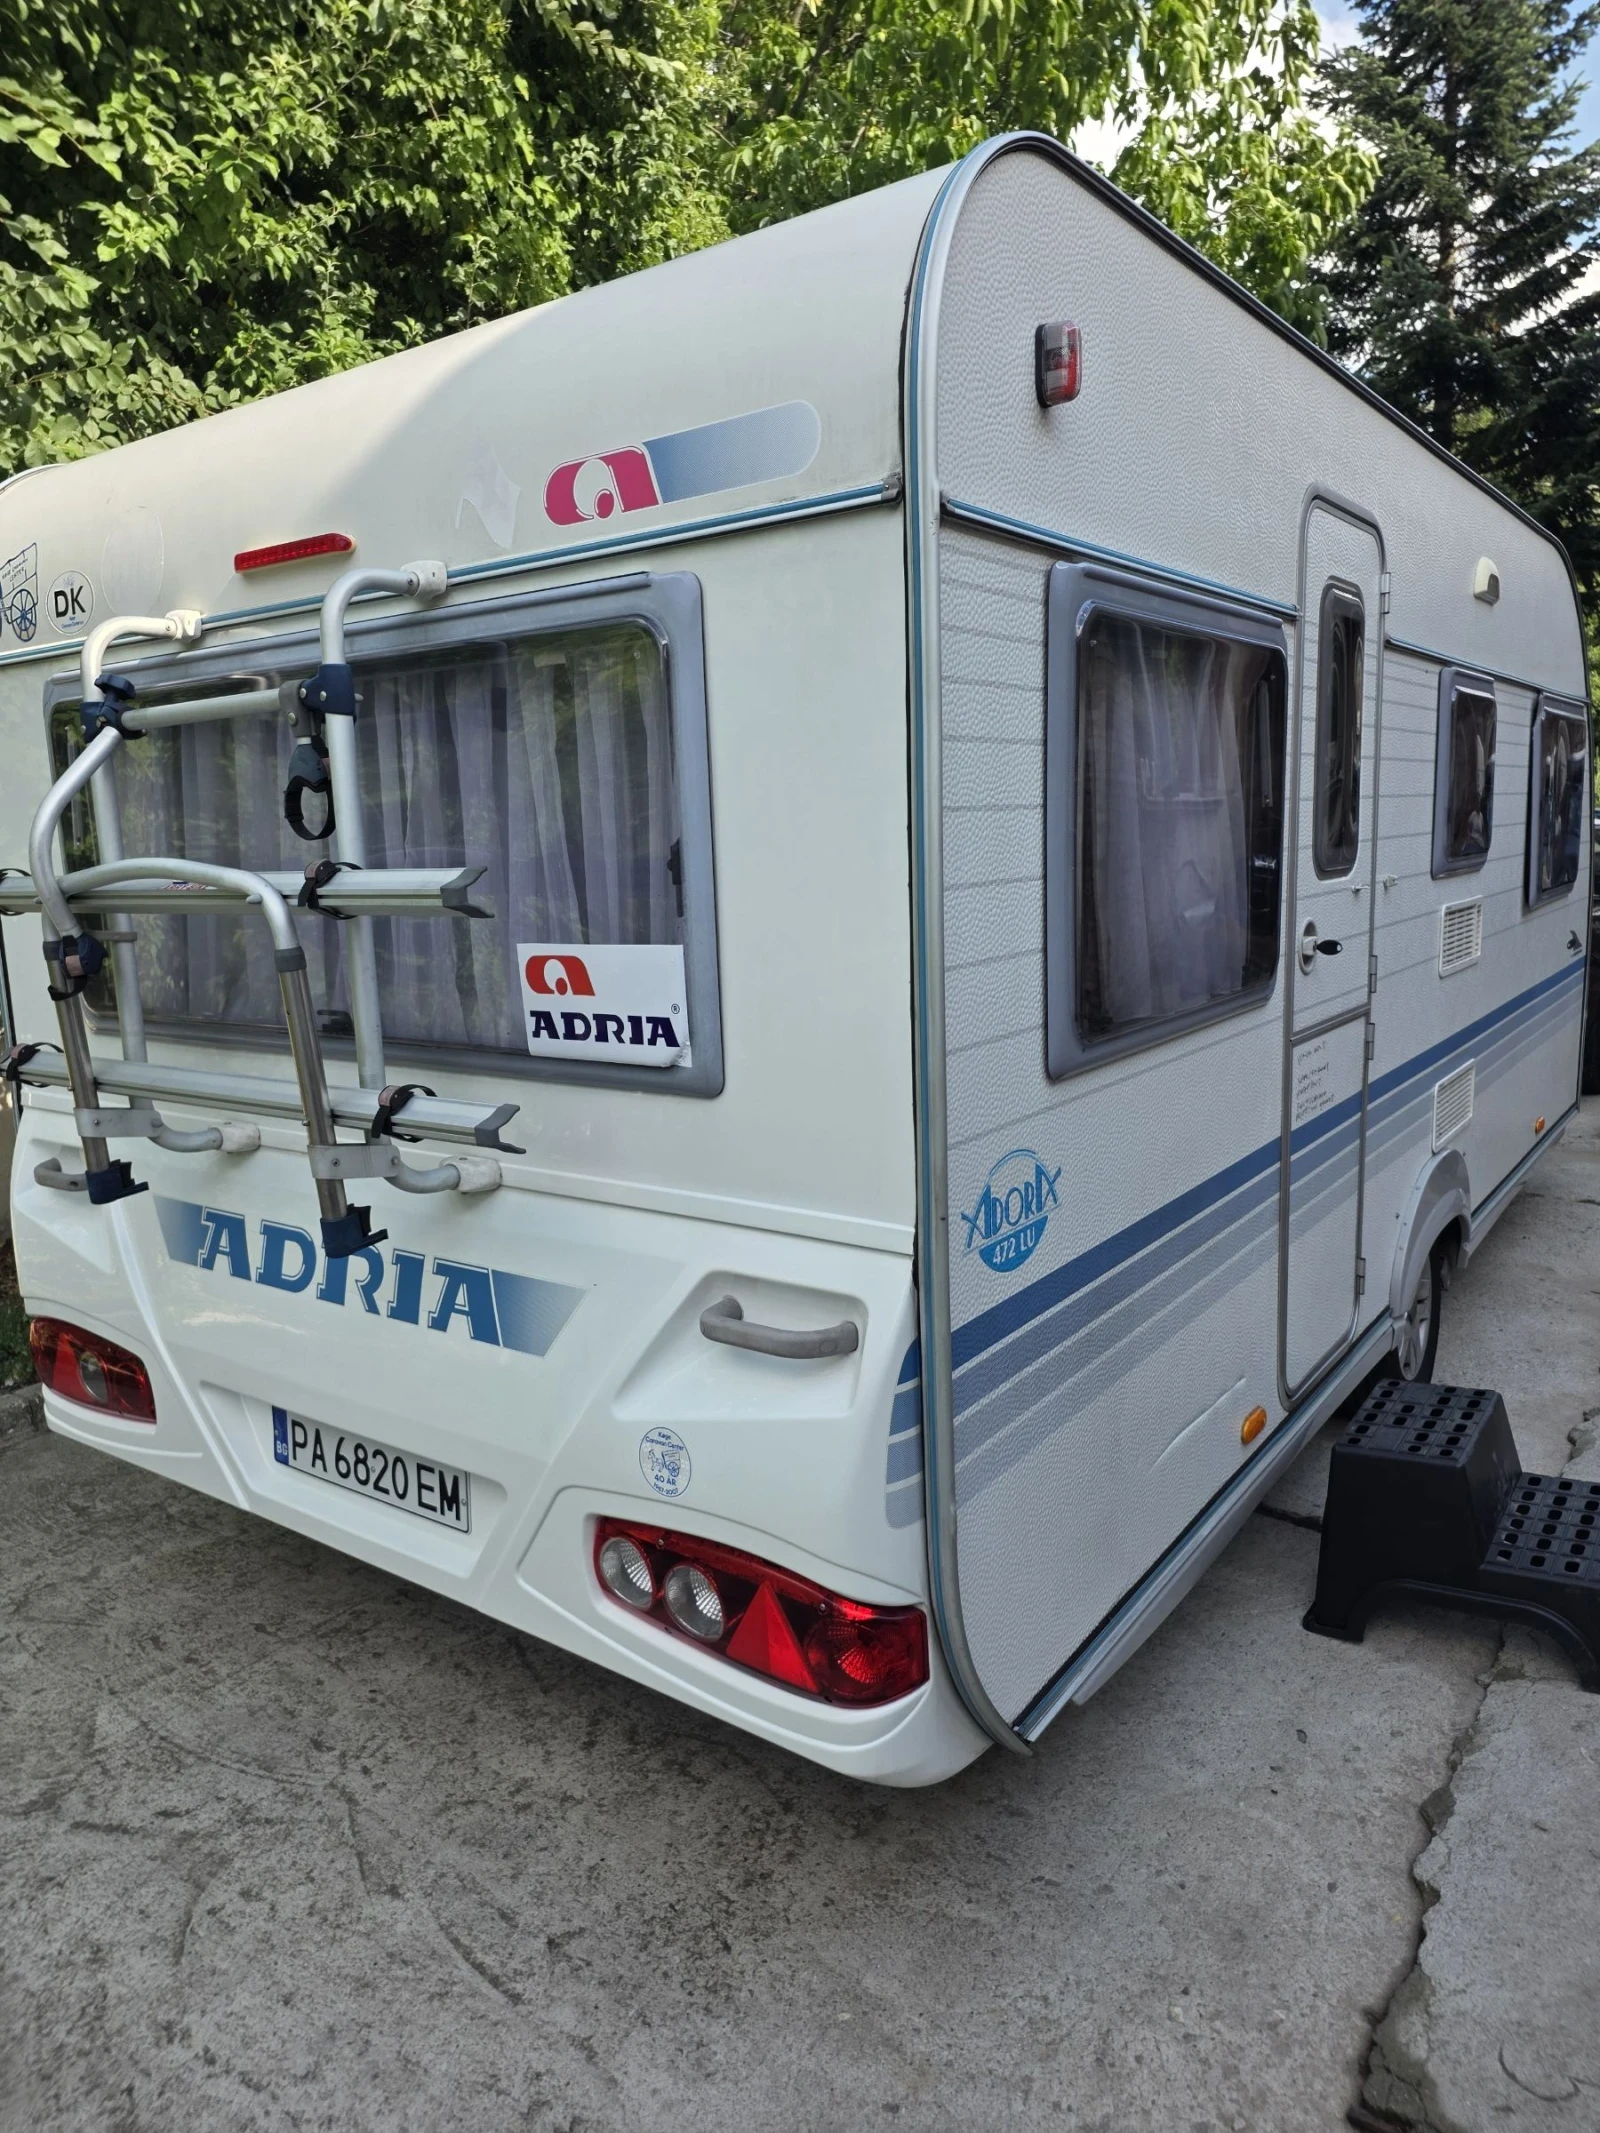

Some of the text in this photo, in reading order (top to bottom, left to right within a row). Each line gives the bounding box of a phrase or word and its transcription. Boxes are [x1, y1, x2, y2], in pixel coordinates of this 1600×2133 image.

[54, 585, 87, 618] DK
[529, 1009, 681, 1048] ADRIA
[992, 1225, 1036, 1265] 472 LU
[200, 1206, 503, 1348] ADRIA
[276, 1440, 288, 1456] BG
[645, 1435, 685, 1452] Caravan Center
[291, 1418, 461, 1522] PA 6820 EM
[654, 1473, 665, 1483] 40
